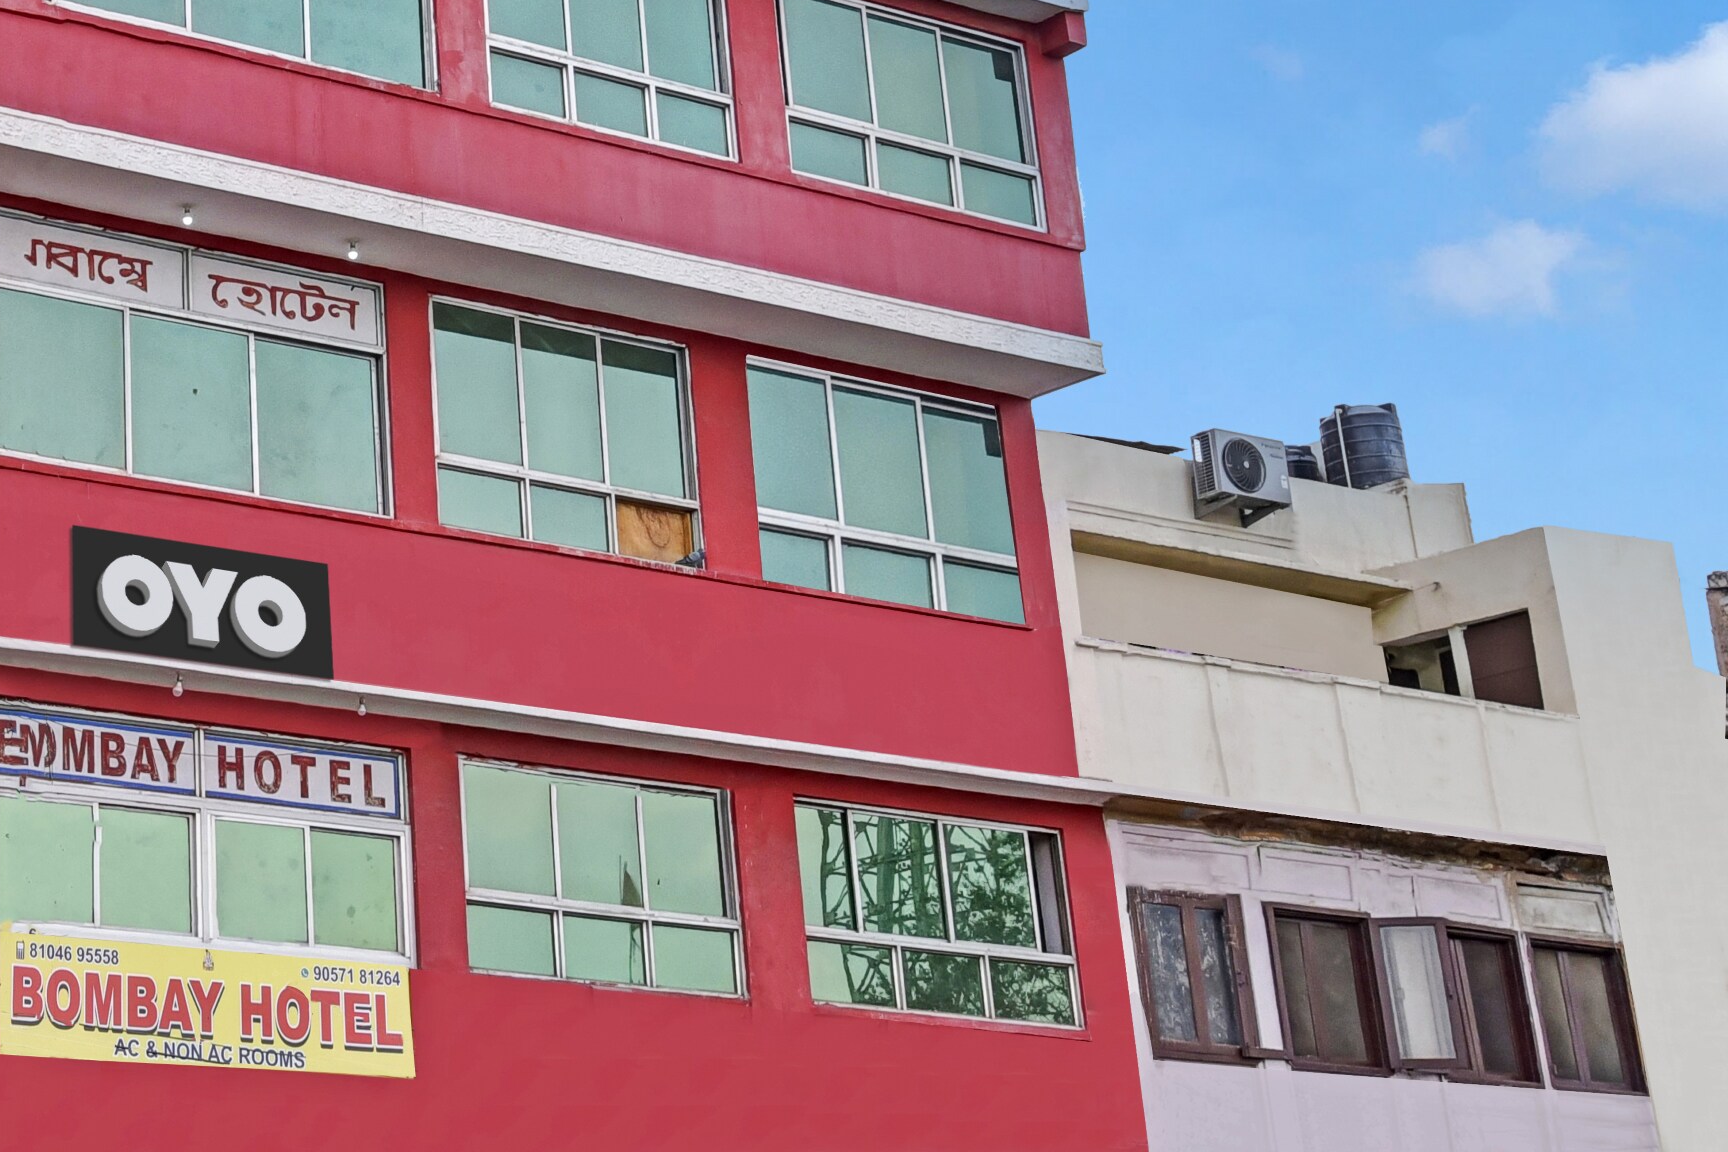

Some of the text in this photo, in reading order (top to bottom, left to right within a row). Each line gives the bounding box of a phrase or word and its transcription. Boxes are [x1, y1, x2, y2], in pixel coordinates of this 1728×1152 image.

[207, 273, 360, 330] হোটেল
[96, 554, 307, 658] OYO
[217, 745, 386, 808] HOTEL
[29, 942, 119, 965] 81046 95558
[313, 966, 400, 986] 90571 81264
[10, 964, 404, 1054] BOMBAY HOTEL
[114, 1038, 306, 1068] AC & NON AC ROOMS
